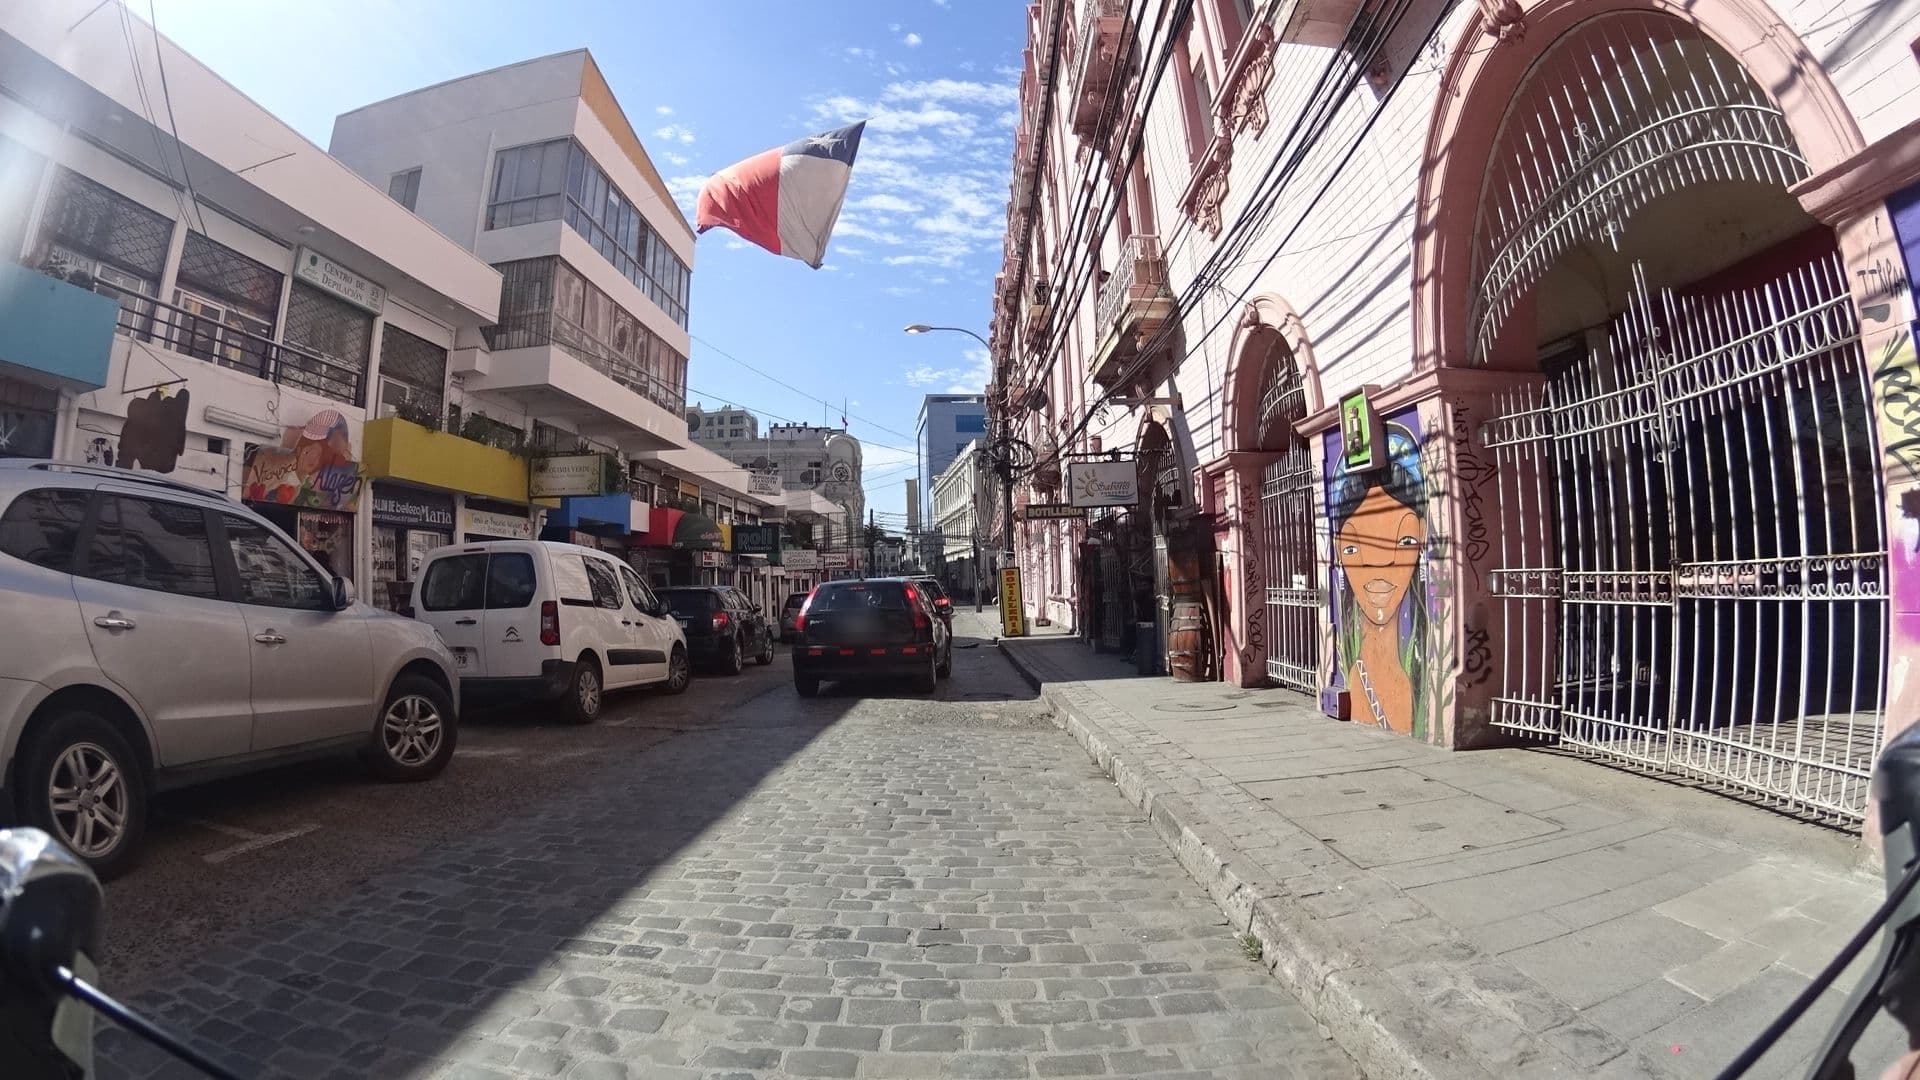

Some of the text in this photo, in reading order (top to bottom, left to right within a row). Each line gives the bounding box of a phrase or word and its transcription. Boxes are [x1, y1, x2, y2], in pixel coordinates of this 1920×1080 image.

[324, 262, 353, 284] CENTRO
[355, 280, 367, 291] DE
[419, 505, 453, 525] Maria
[1027, 507, 1084, 518] BOTILLERIA
[737, 528, 773, 550] poli
[1005, 570, 1020, 633] BOTILLERIA
